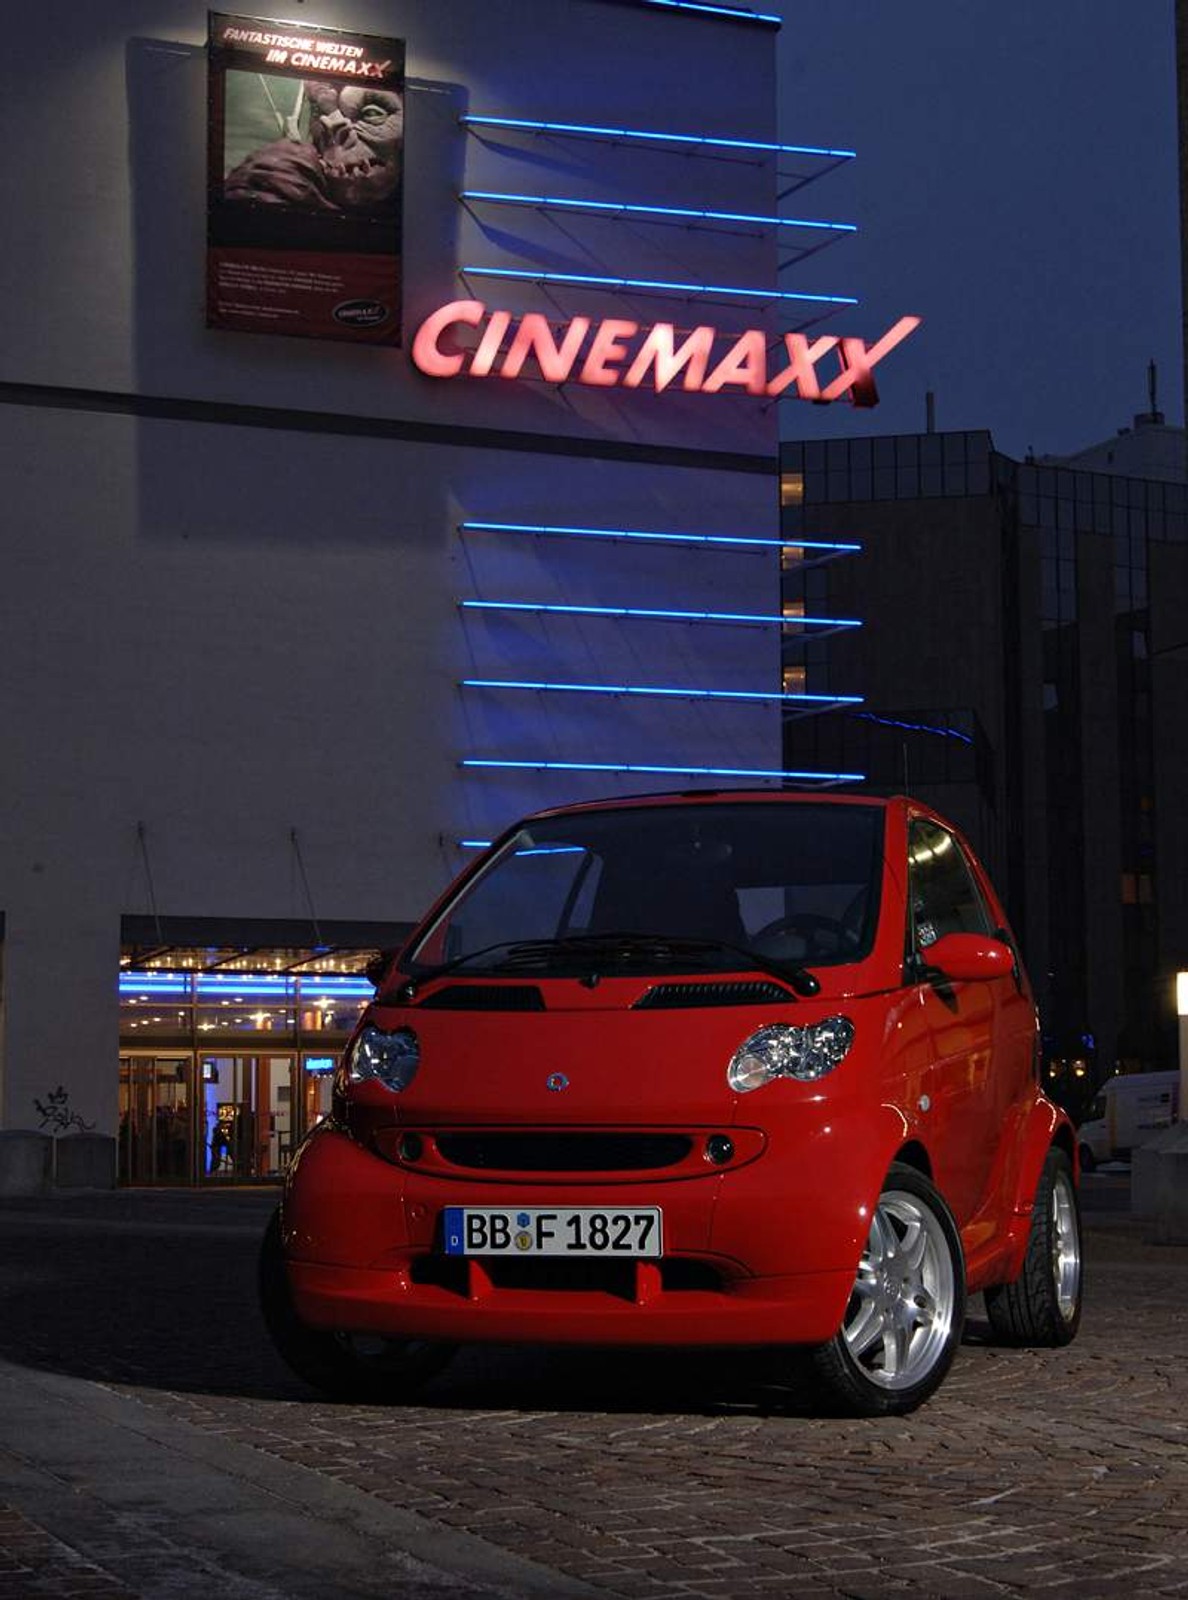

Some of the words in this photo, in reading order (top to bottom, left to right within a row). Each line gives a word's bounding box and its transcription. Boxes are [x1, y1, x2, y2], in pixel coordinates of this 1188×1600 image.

[223, 27, 314, 52] FANTASTISCHE
[315, 41, 364, 57] WELTEN
[265, 50, 287, 64] IM
[290, 53, 392, 78] CINEMAXX
[411, 299, 922, 407] CINEMAXX
[466, 1213, 511, 1250] BB
[536, 1214, 558, 1250] F
[566, 1214, 655, 1251] 1827
